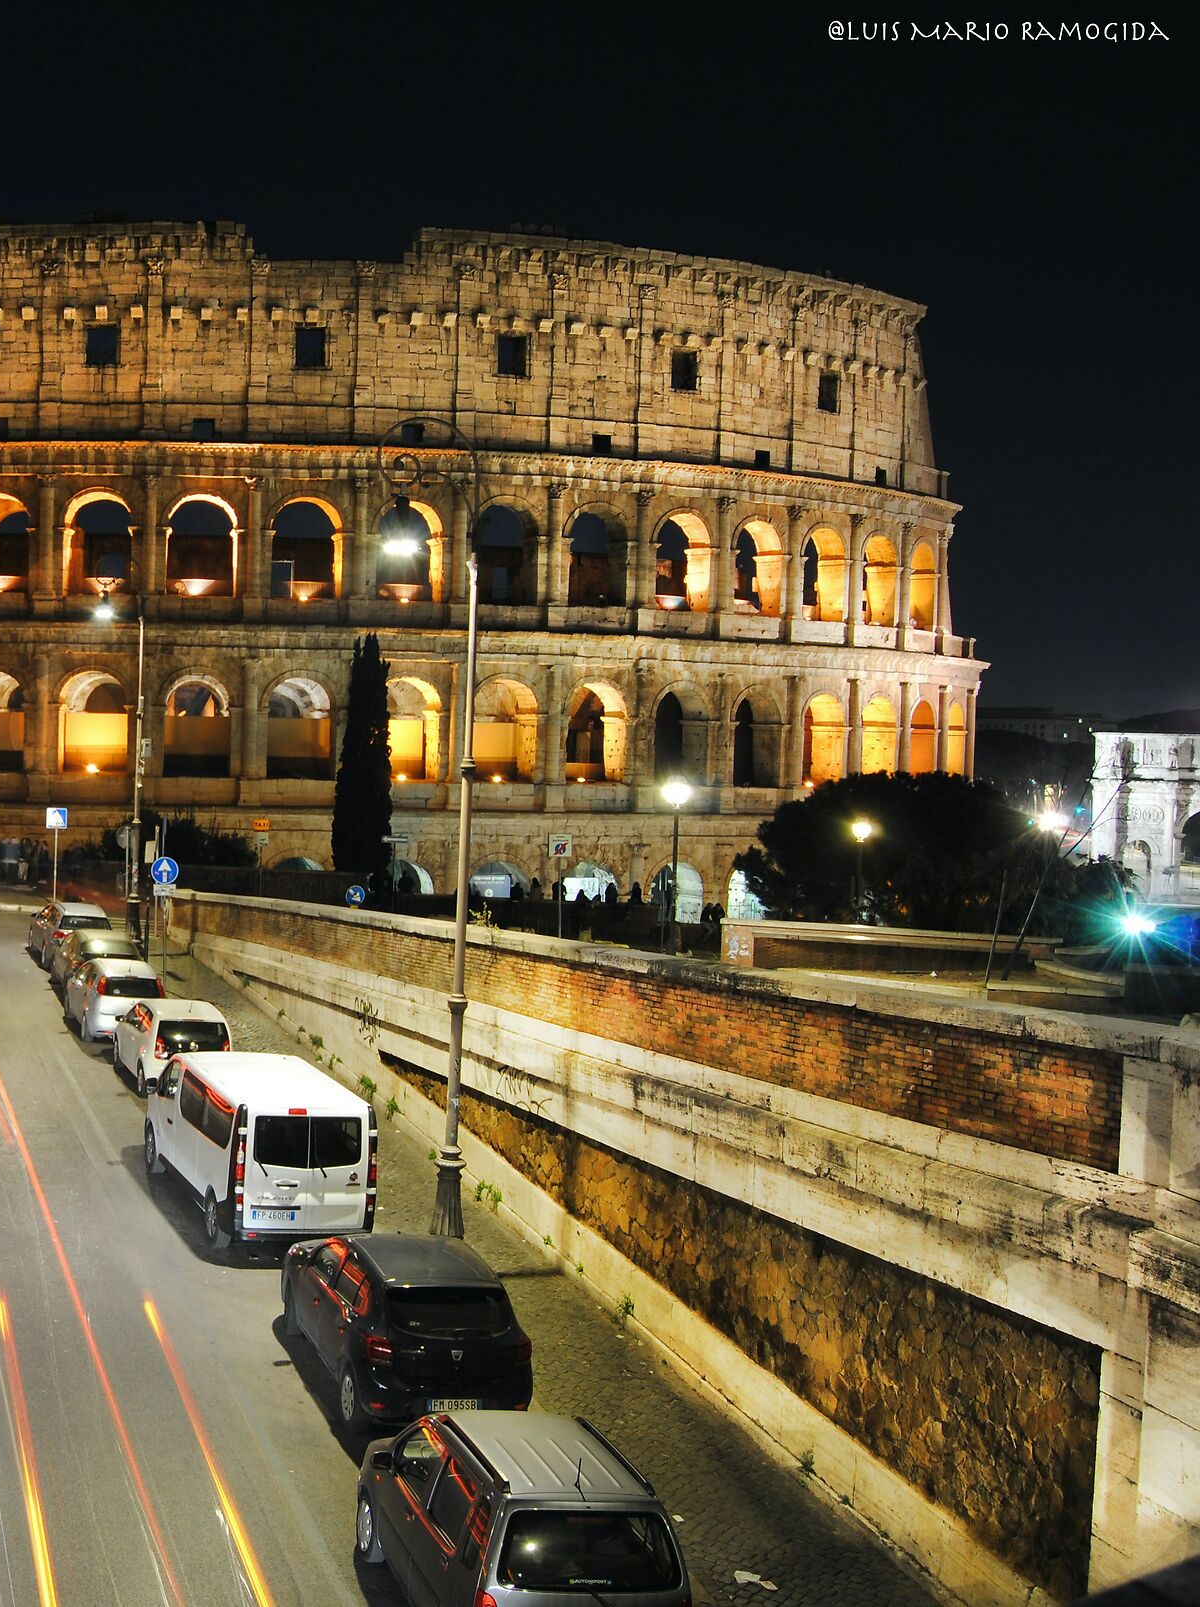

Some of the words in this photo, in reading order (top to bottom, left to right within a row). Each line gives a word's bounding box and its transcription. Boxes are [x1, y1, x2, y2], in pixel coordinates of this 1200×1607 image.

[257, 1211, 266, 1219] FP
[433, 1400, 445, 1410] FM
[447, 1400, 476, 1410] 095SB
